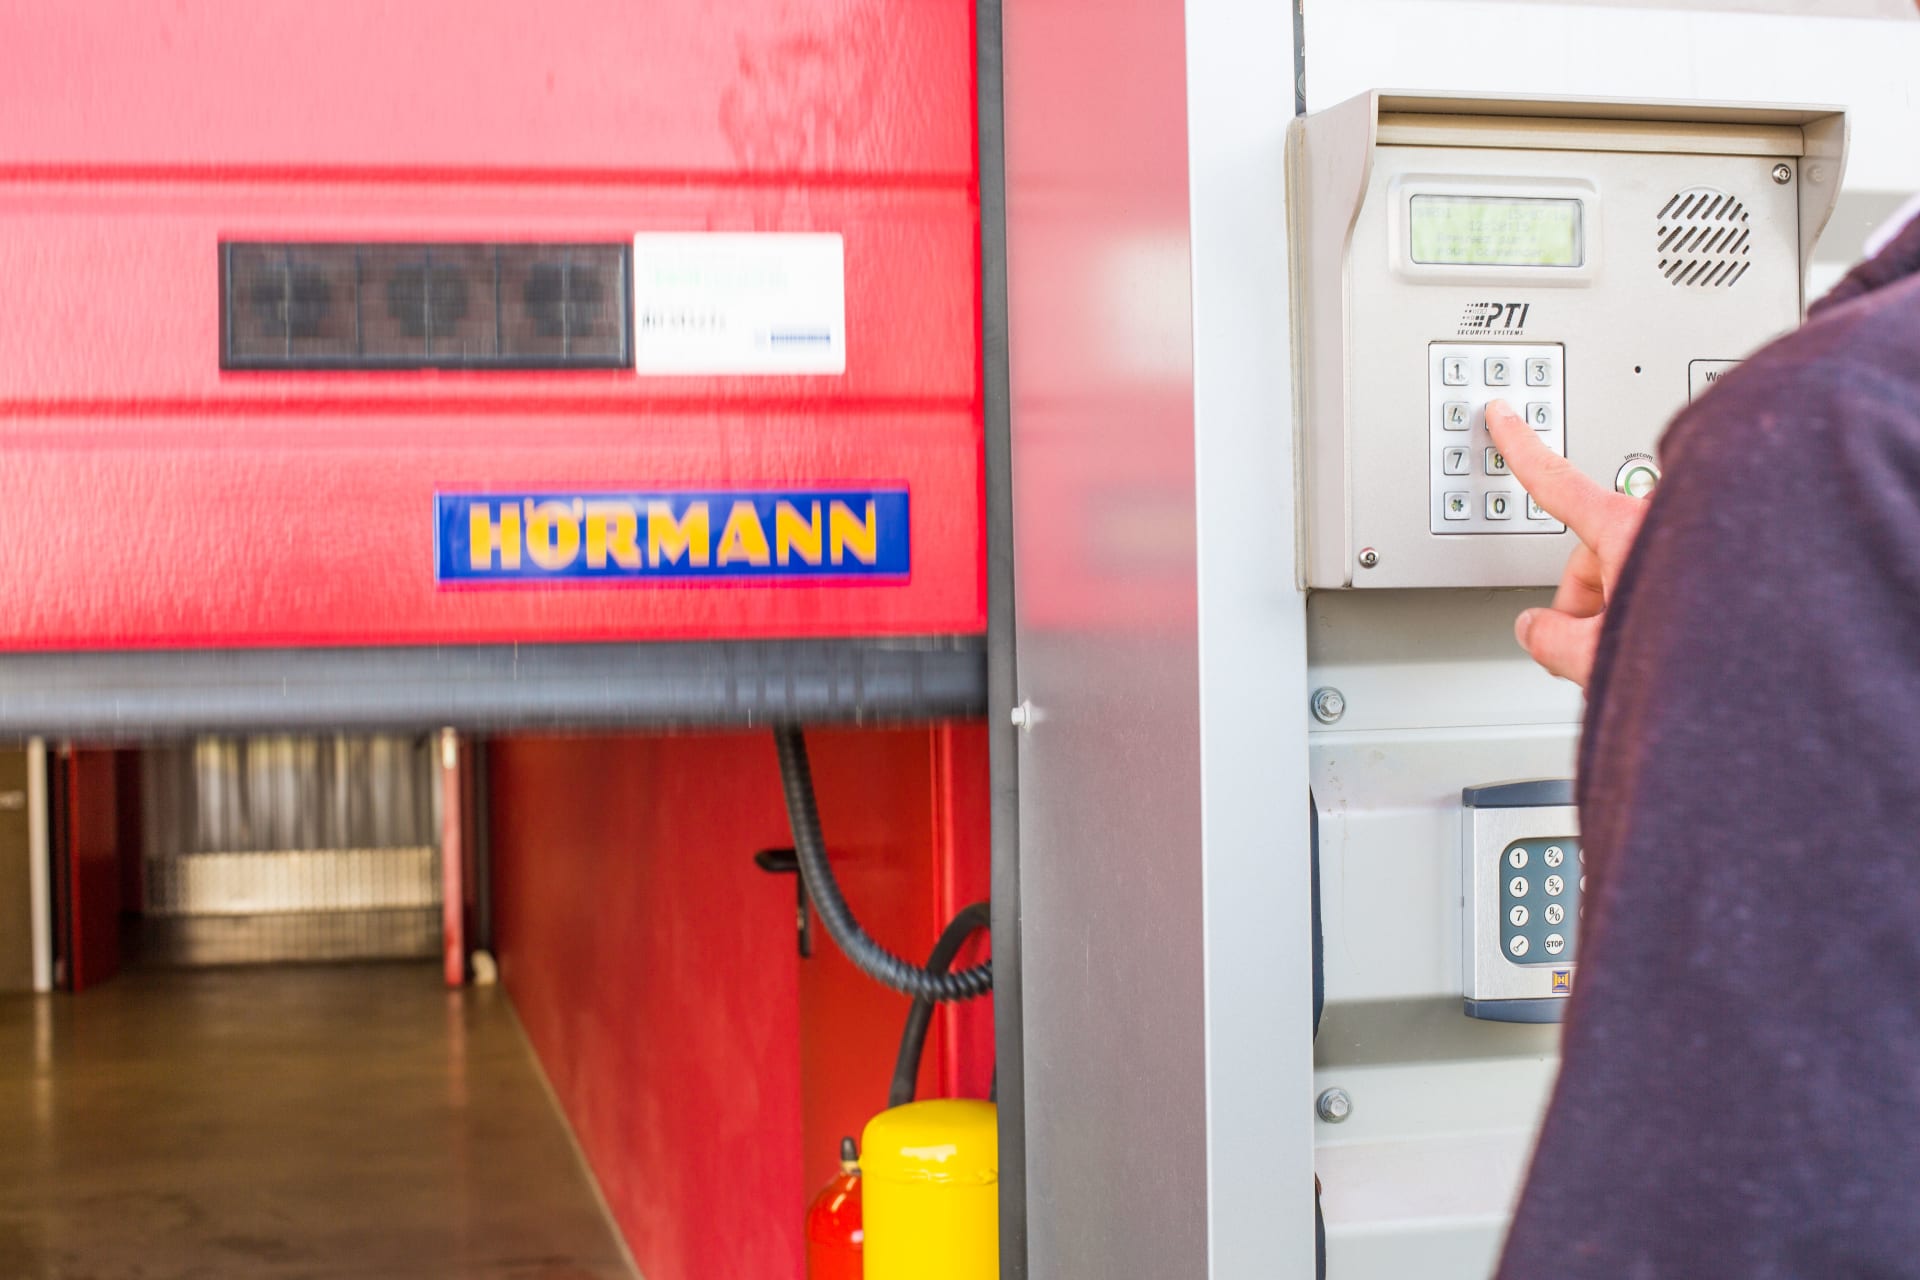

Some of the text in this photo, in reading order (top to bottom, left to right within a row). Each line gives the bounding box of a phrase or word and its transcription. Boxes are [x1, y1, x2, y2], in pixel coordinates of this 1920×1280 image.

[1485, 302, 1530, 328] PTI
[1453, 363, 1545, 381] 1 2 3
[1451, 407, 1546, 424] 4 6
[1453, 452, 1505, 469] 7 8
[1623, 452, 1654, 462] Intercom
[1493, 497, 1506, 514] 0
[469, 496, 877, 570] HÖRMANN
[1515, 852, 1521, 864] 1
[1515, 880, 1523, 892] 4
[1515, 909, 1523, 921] 7
[1546, 940, 1563, 948] STOP
